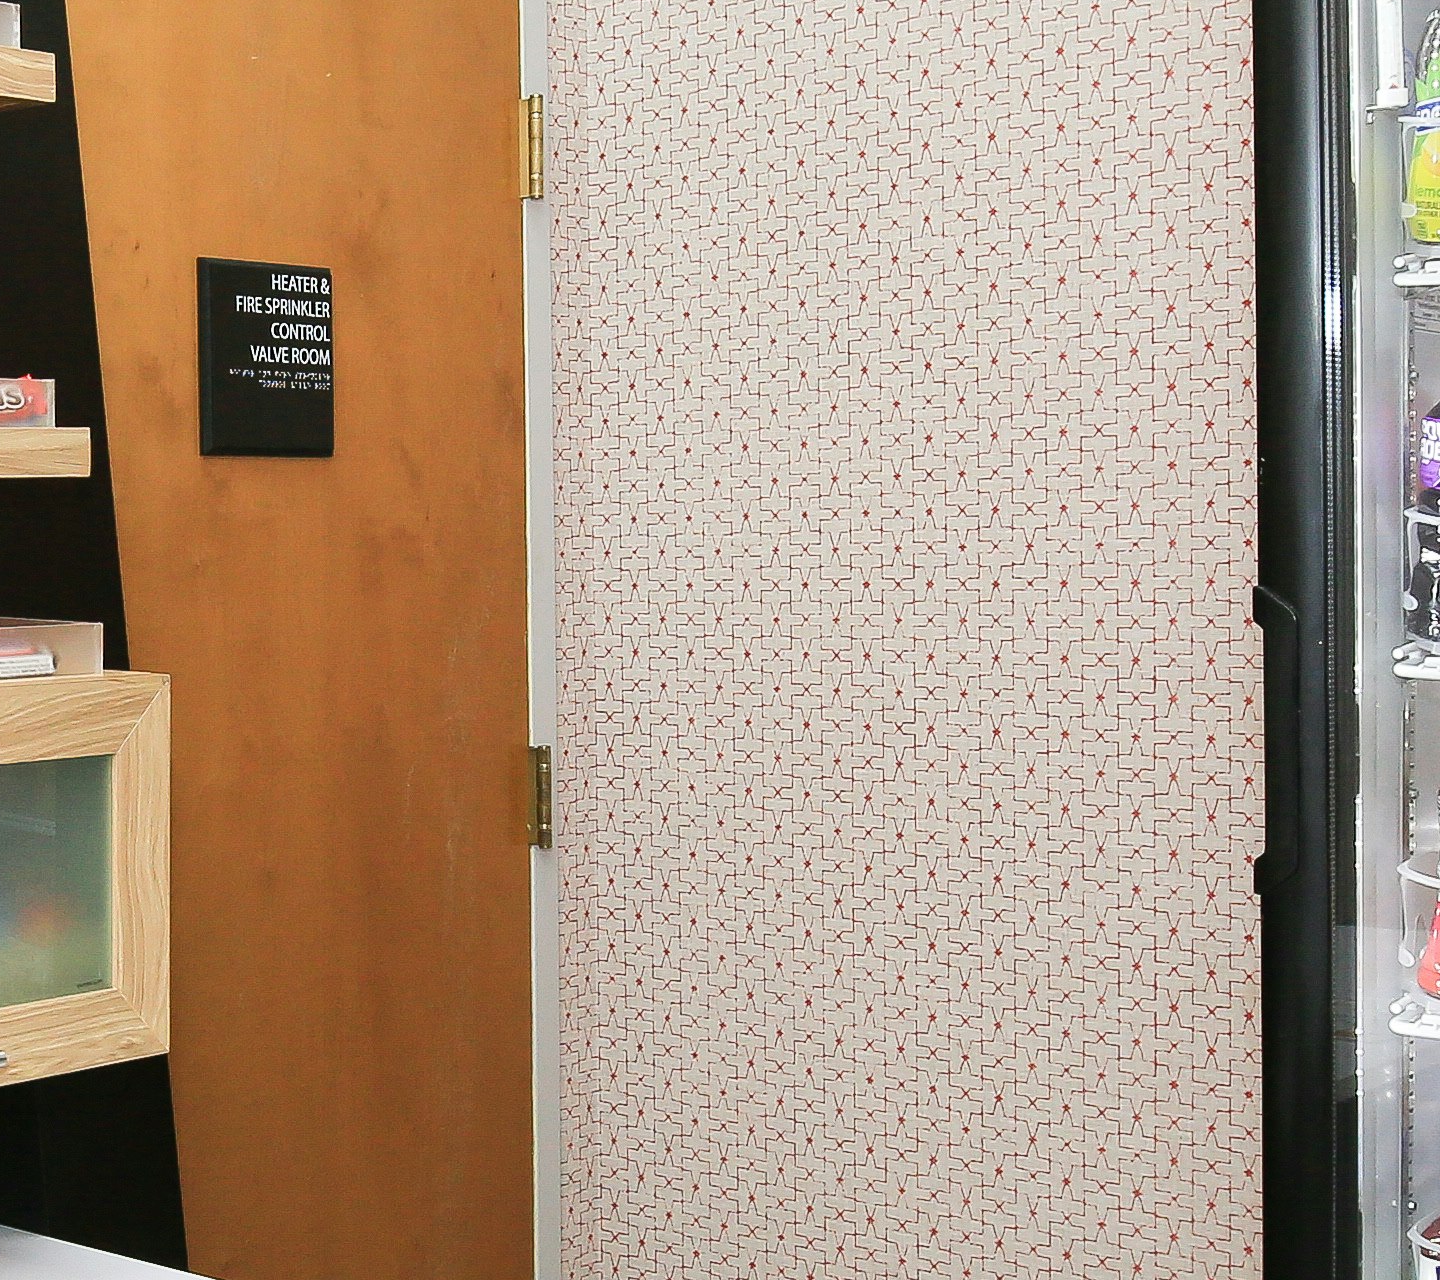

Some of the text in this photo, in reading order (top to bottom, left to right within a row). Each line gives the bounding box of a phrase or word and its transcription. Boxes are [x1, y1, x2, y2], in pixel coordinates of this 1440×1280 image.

[272, 274, 330, 294] HEATER &
[236, 296, 330, 318] FIRE SPRINKLER
[271, 323, 330, 342] CONTROL
[250, 345, 330, 365] VALVE ROOM
